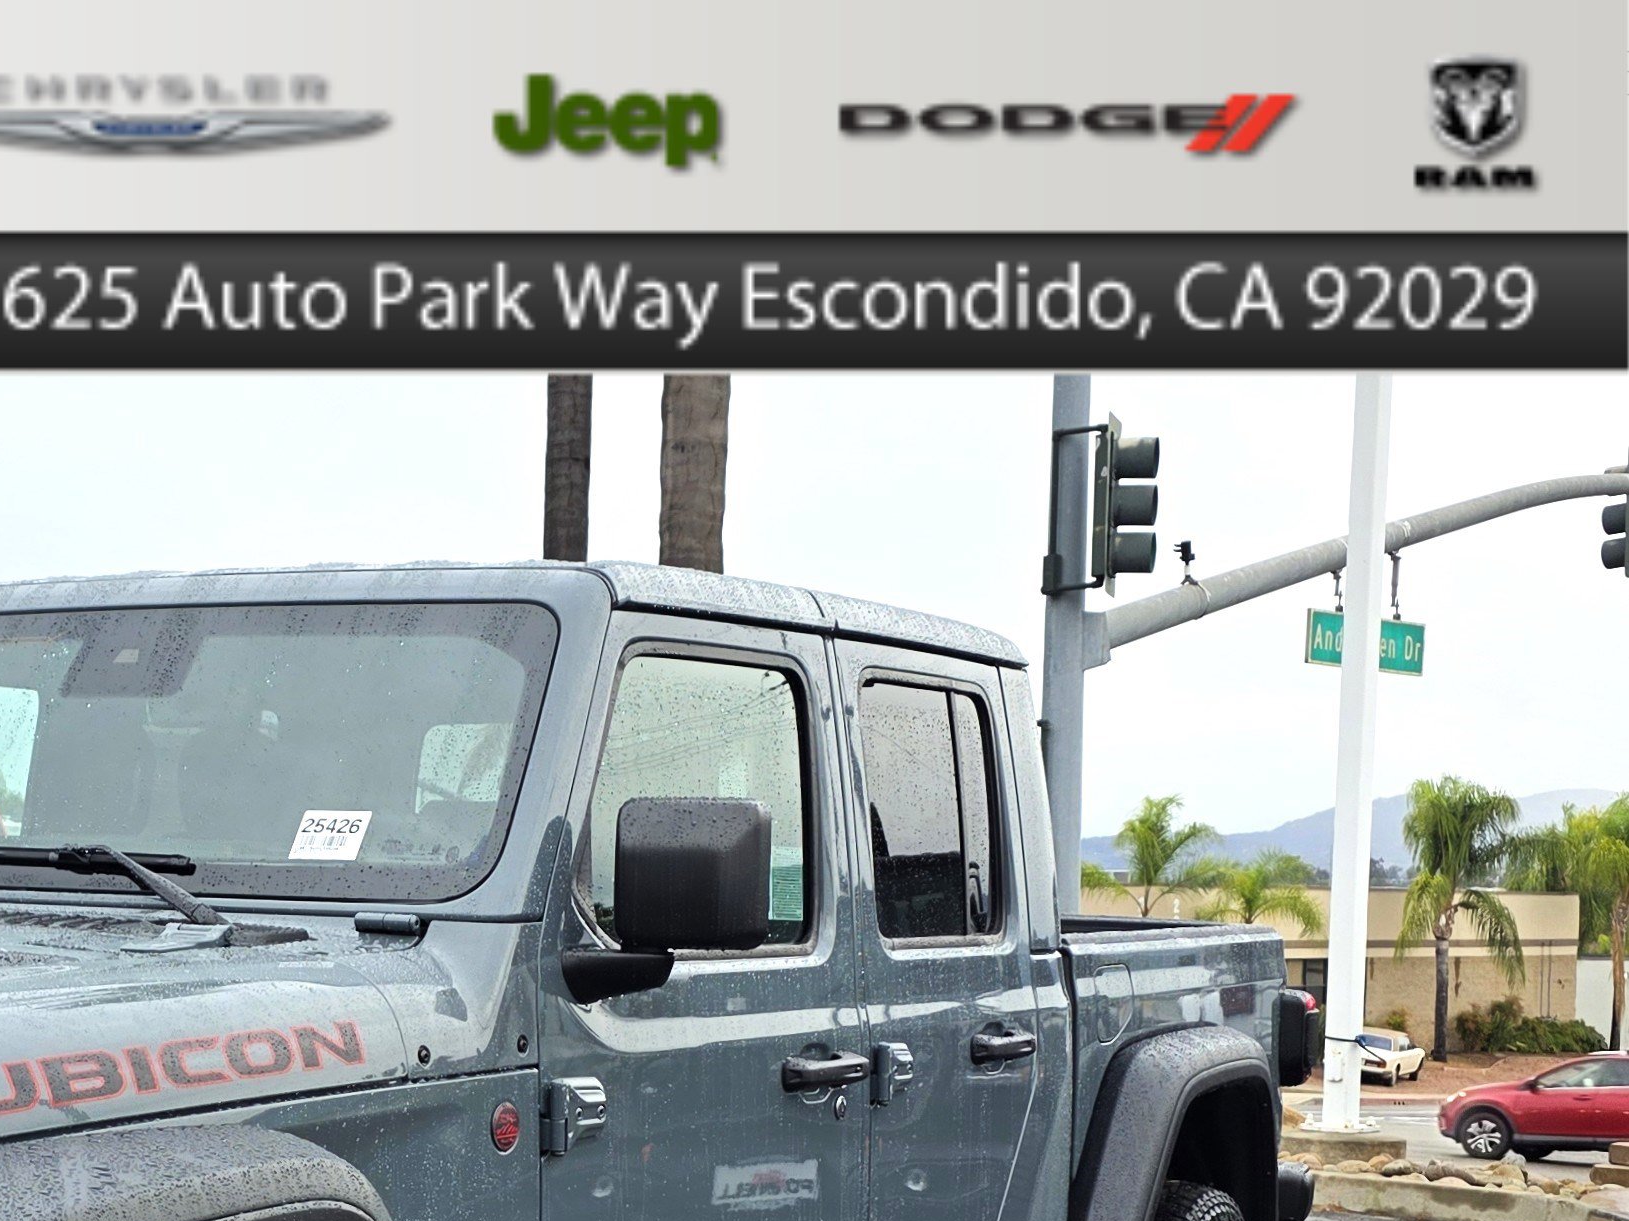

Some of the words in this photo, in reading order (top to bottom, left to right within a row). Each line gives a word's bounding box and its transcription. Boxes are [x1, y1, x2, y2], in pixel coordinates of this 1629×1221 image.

[1314, 623, 1396, 659] Anden
[1404, 635, 1421, 662] Dr
[301, 818, 362, 834] 25426
